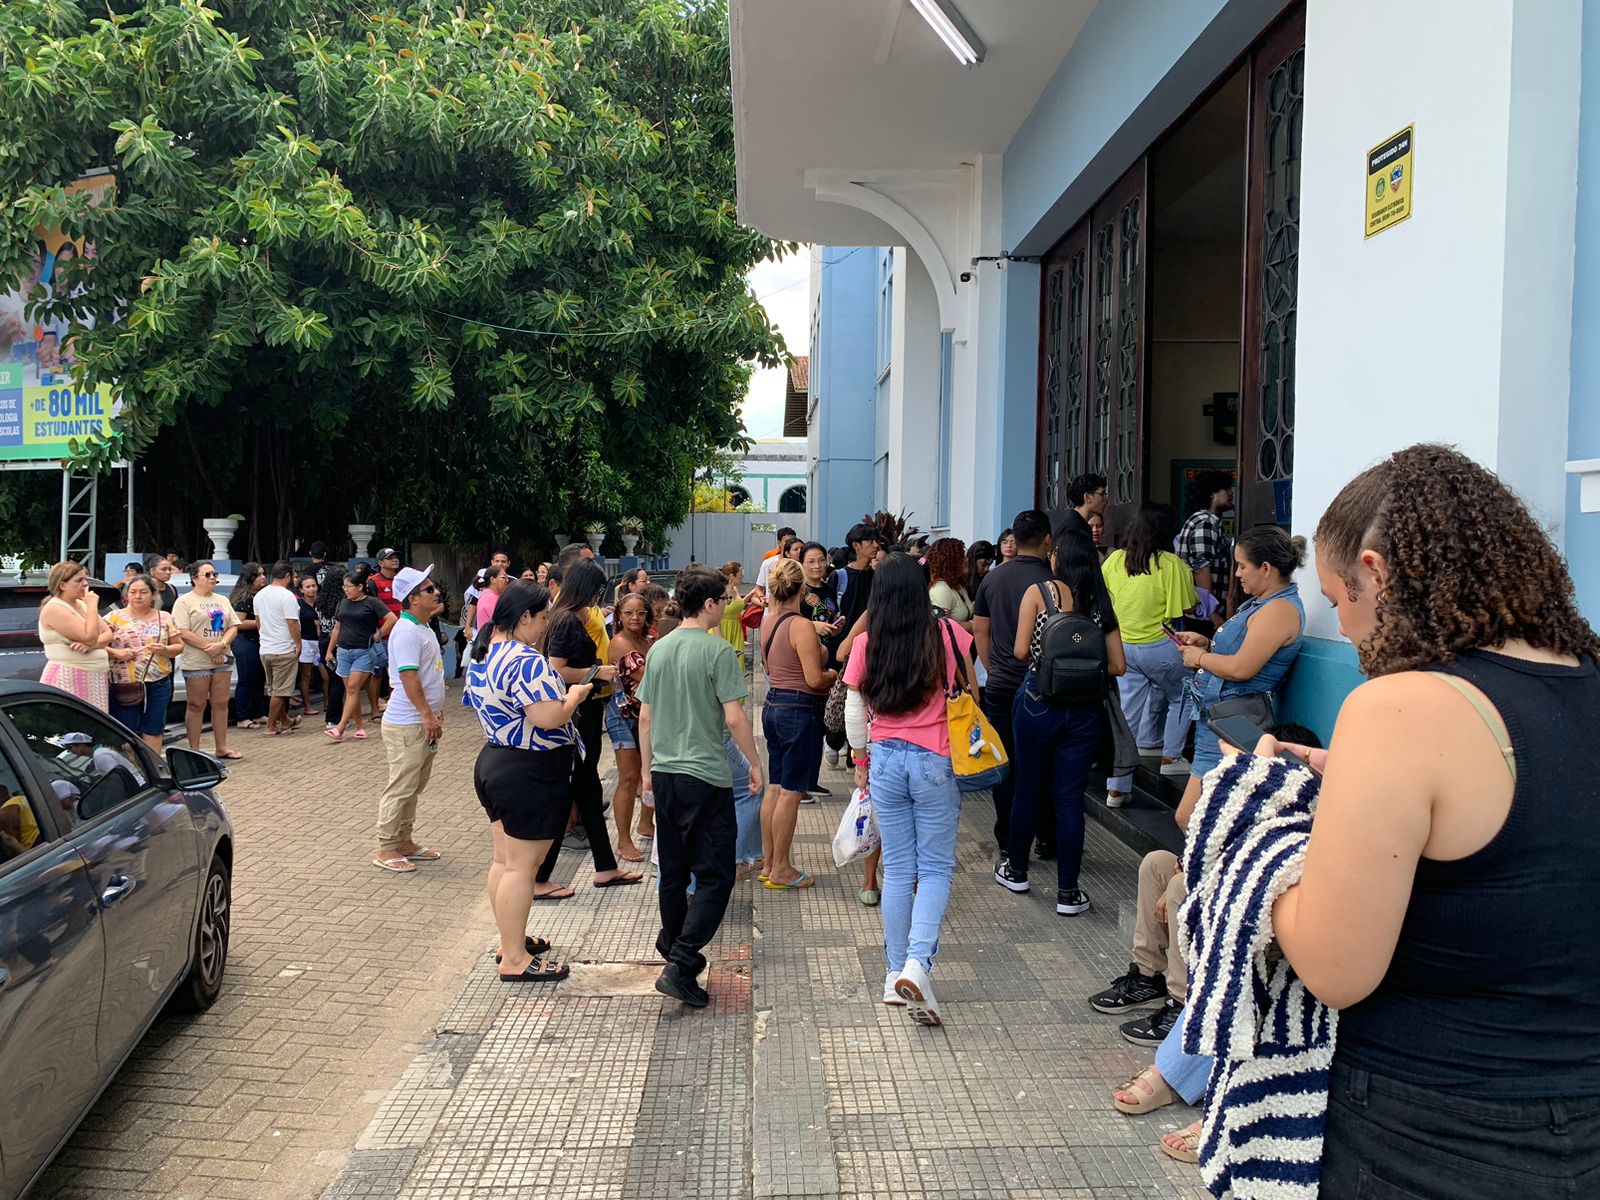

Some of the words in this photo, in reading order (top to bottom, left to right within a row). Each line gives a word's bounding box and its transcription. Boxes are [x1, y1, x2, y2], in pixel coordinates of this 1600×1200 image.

[49, 388, 71, 417] 80
[75, 391, 104, 416] MIL
[34, 419, 103, 437] ESTUDANTES
